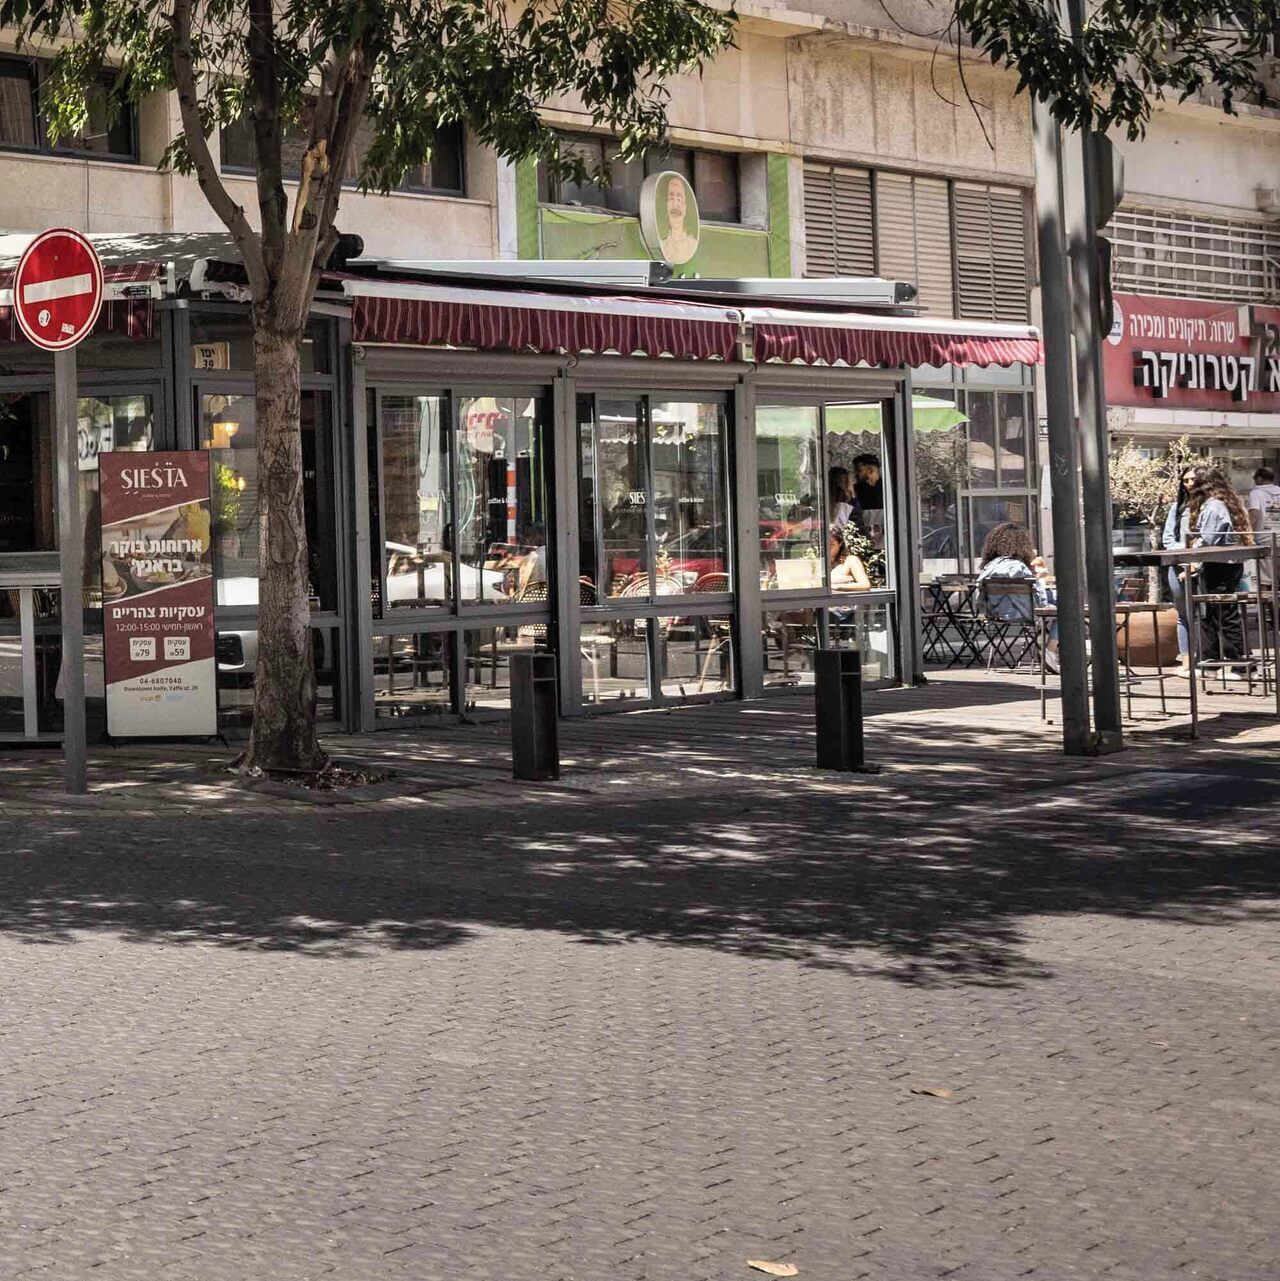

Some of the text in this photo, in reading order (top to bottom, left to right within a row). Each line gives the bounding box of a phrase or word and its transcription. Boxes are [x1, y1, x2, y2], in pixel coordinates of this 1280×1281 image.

[1129, 314, 1166, 338] ומכירה
[1168, 314, 1206, 347] תיקונים
[200, 348, 215, 358] יפו
[110, 539, 202, 558] ארוחות בוקר
[112, 606, 205, 620] עסקיות צהריים
[115, 622, 203, 632] ראשון-חמישי 12:00-15:00
